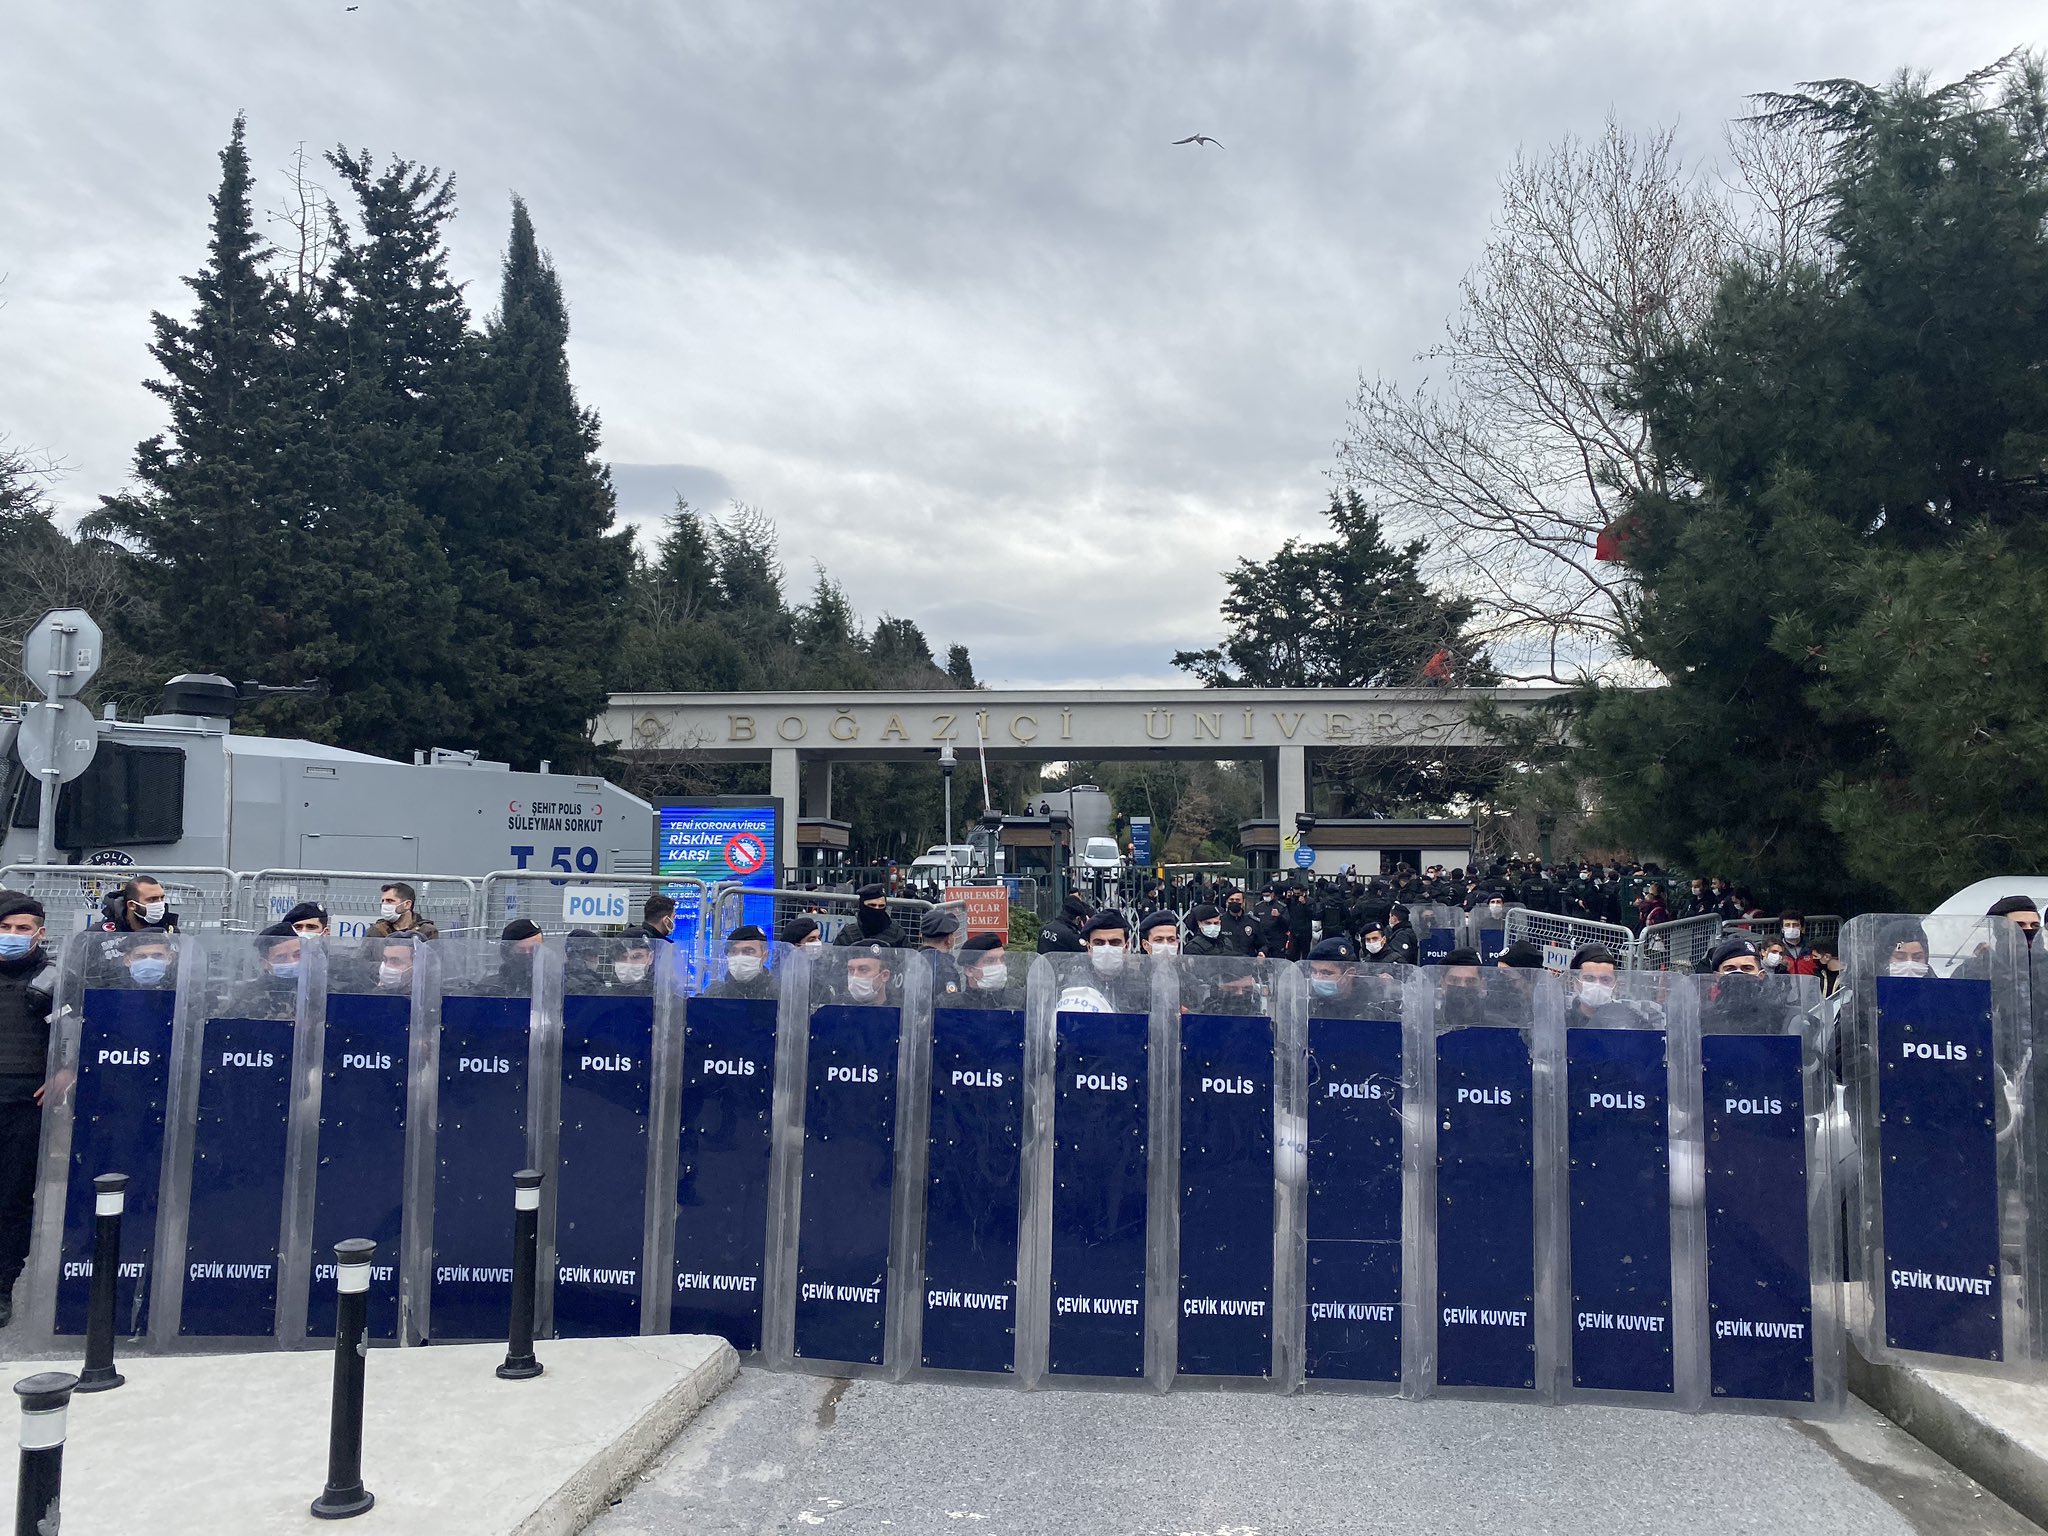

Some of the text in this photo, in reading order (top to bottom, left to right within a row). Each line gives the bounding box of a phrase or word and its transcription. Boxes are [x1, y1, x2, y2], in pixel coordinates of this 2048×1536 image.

[727, 707, 1072, 747] BOĞAZİÇİ
[532, 802, 582, 816] ŞEHİT POLİS
[508, 814, 603, 833] SÜLEYMAN SORKUT
[669, 819, 767, 831] YENİ KORONAVİRUS
[668, 831, 723, 846] RİSKİNE
[95, 852, 129, 865] POLİS
[668, 849, 710, 862] KARŞI
[551, 846, 599, 886] 59
[948, 888, 1006, 900] AMBLEMSİZ
[569, 893, 625, 917] POLİS
[966, 903, 1001, 915] AÇLAR
[966, 916, 1000, 926] REMEZ
[98, 1047, 150, 1065] POLİS
[222, 1049, 274, 1068] POLİS
[342, 1051, 391, 1070] POLİS
[1902, 1040, 1968, 1061] POLİS
[459, 1055, 510, 1074] POLİS
[581, 1053, 632, 1072] POLİS
[703, 1057, 755, 1076] POLİS
[827, 1064, 879, 1084] POLİS
[951, 1068, 1003, 1088] POLİS
[1076, 1072, 1128, 1091] POLİS
[1201, 1075, 1254, 1095] POLİS
[1328, 1079, 1382, 1100] POLİS
[1457, 1085, 1512, 1105] POLİS
[1589, 1090, 1646, 1110] POLİS
[1725, 1095, 1782, 1115] POLİS
[189, 1260, 272, 1282] ÇEVİK KUVVET
[436, 1263, 470, 1285] ÇEVİK
[559, 1264, 636, 1286] ÇEVİK KUVVET
[677, 1270, 757, 1292] ÇEVİK KUVVET
[801, 1280, 881, 1304] ÇEVİK KUVVET
[1891, 1268, 1993, 1296] ÇEVİK KUVVET
[927, 1288, 1009, 1311] ÇEVİK KUVVET
[1056, 1294, 1139, 1316] ÇEVİK KUVVET
[1183, 1295, 1266, 1318] ÇEVİK KUVVET
[1311, 1300, 1394, 1322] ÇEVİK KUVVET
[1443, 1305, 1527, 1328] ÇEVİK KUVVET
[1577, 1309, 1665, 1333] ÇEVİK KUVVET
[1715, 1317, 1805, 1340] ÇEVİK KUVVET
